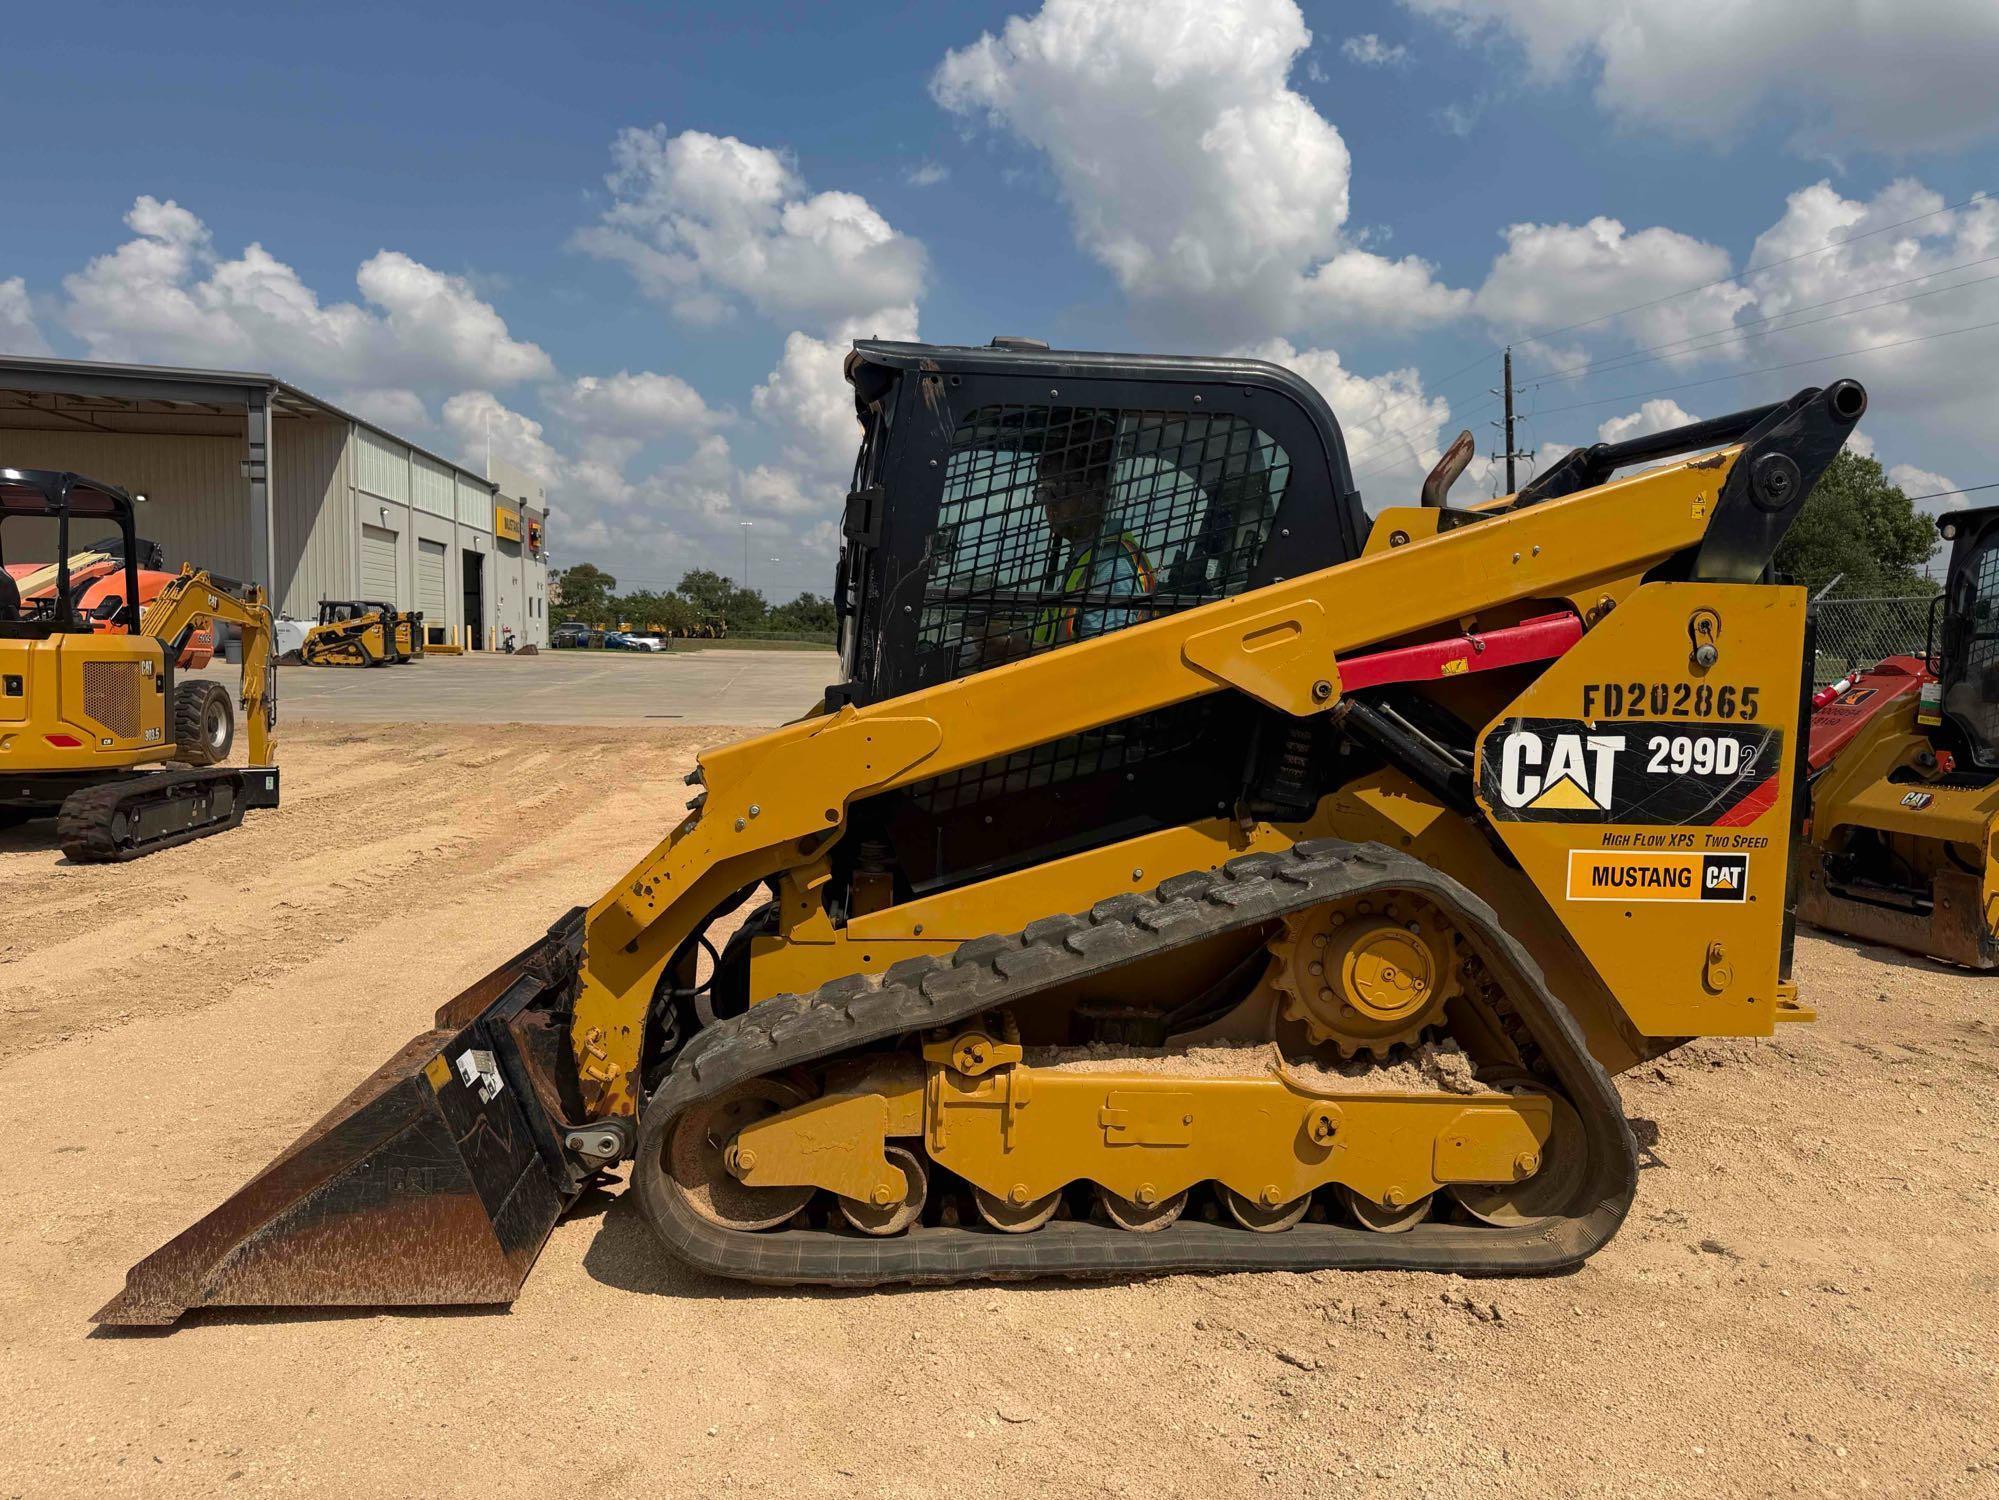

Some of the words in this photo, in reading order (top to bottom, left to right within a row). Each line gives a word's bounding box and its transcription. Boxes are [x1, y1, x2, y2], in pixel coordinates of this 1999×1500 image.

[208, 594, 217, 608] CAT
[142, 660, 152, 675] CAT
[1583, 683, 1760, 720] FD202865
[1500, 732, 1626, 810] CAT
[1900, 792, 1931, 808] CAT
[1668, 834, 1695, 847] XPS
[1592, 866, 1691, 888] MUSTANG
[1706, 866, 1744, 889] CAT
